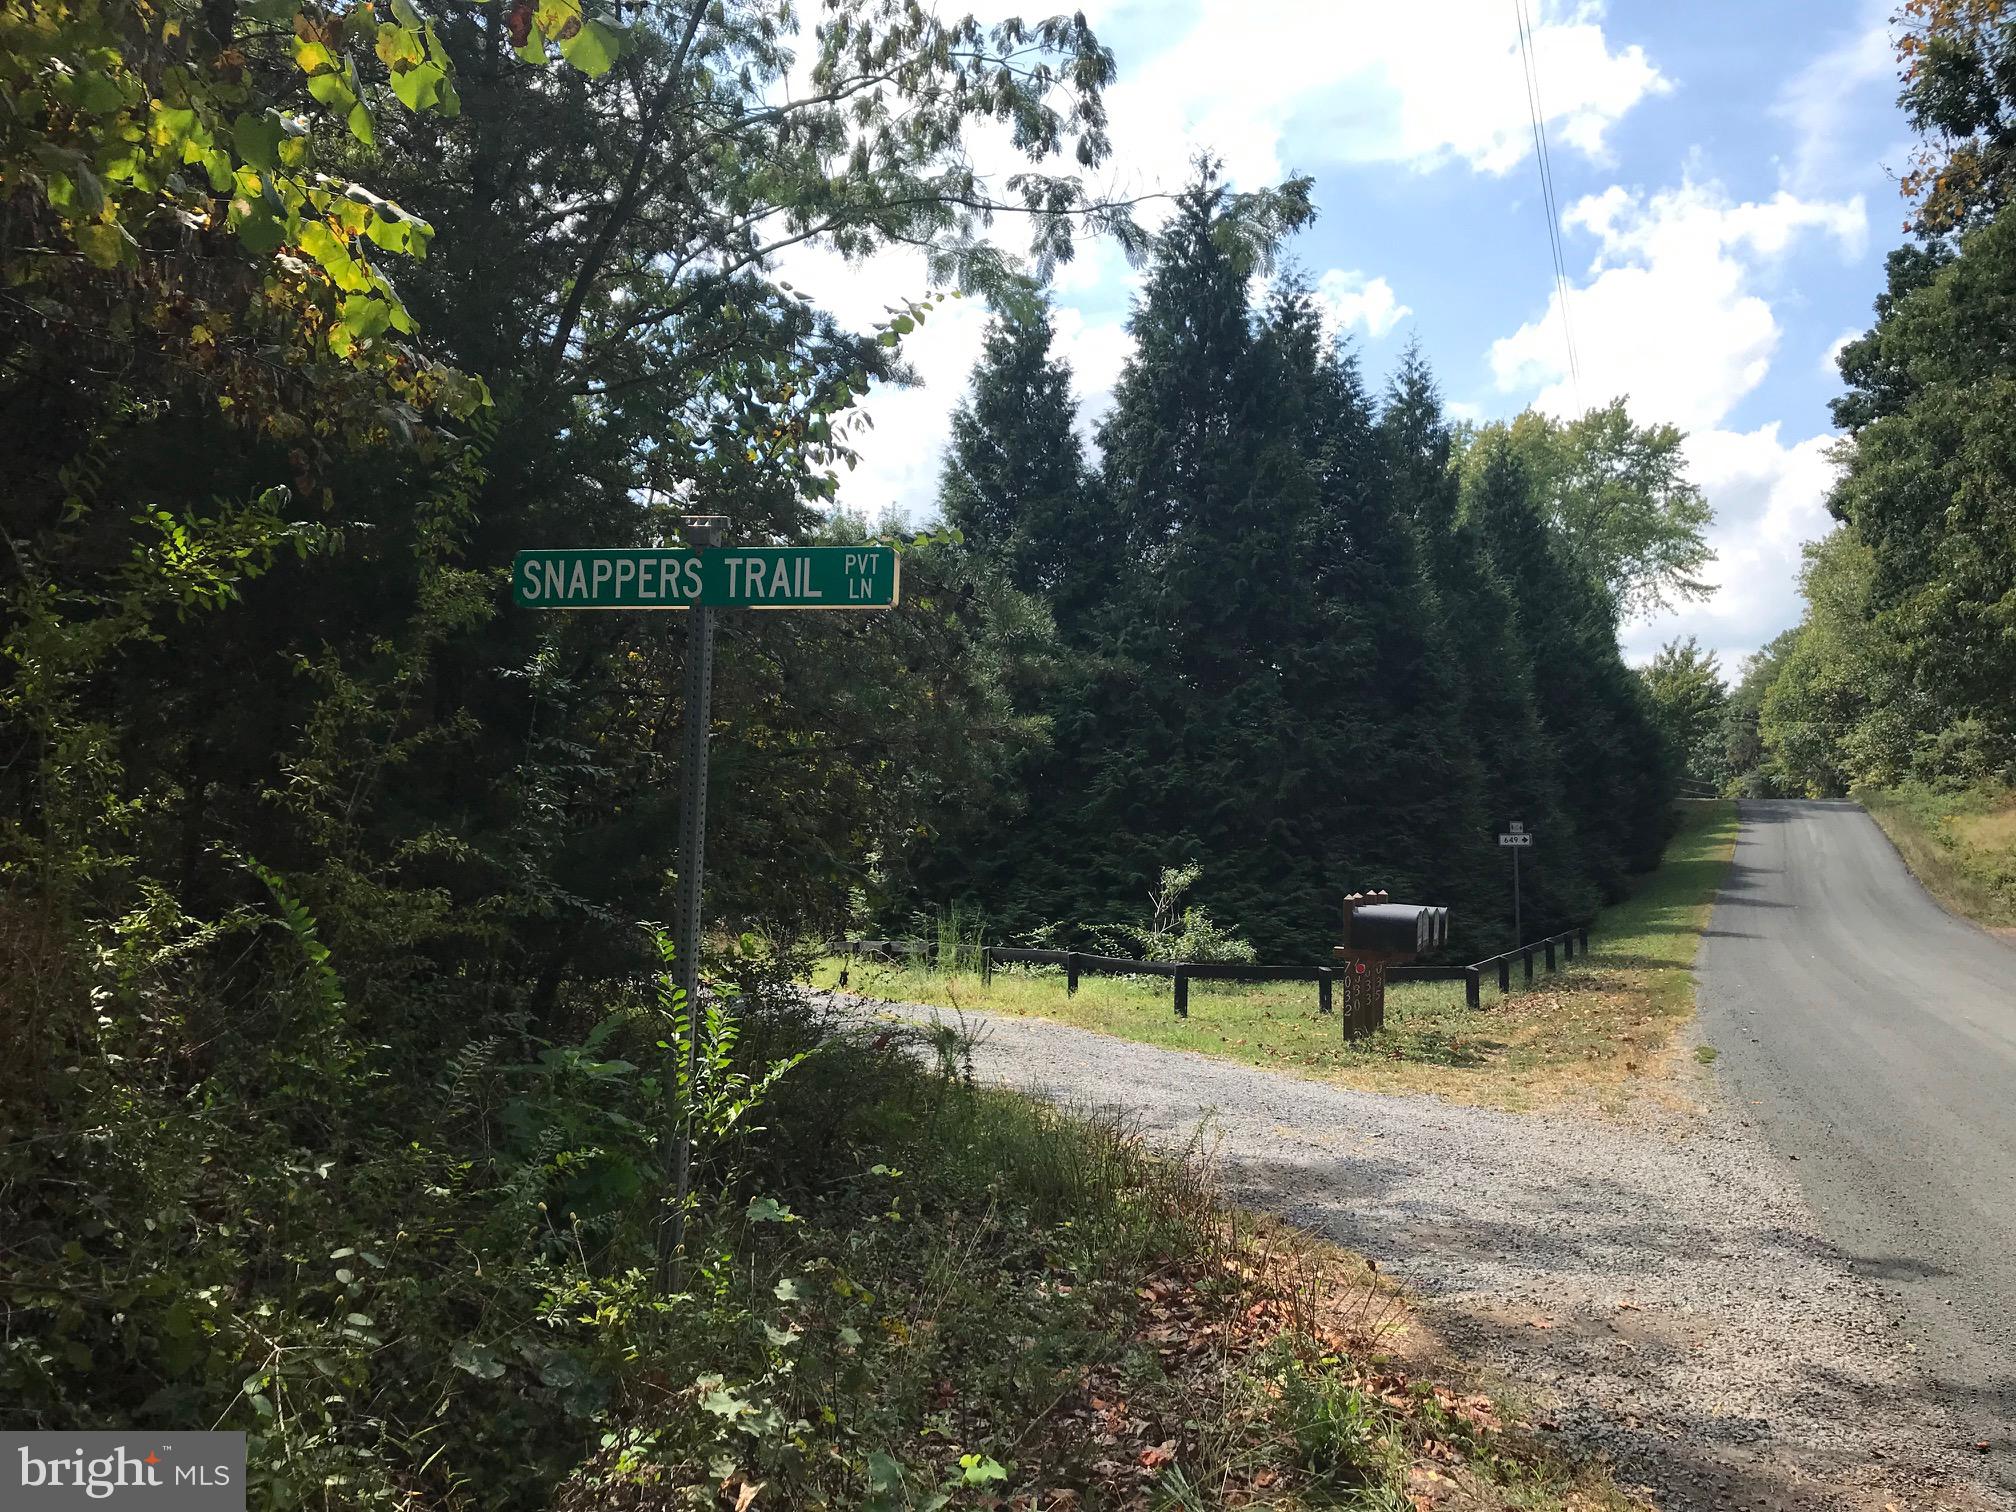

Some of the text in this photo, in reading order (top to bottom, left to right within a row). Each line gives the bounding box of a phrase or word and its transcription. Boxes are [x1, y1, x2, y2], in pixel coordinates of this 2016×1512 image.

[845, 553, 880, 574] PVT
[522, 557, 822, 599] SNAPPERS TRAIL
[849, 578, 872, 599] LN
[1504, 836, 1518, 844] 649
